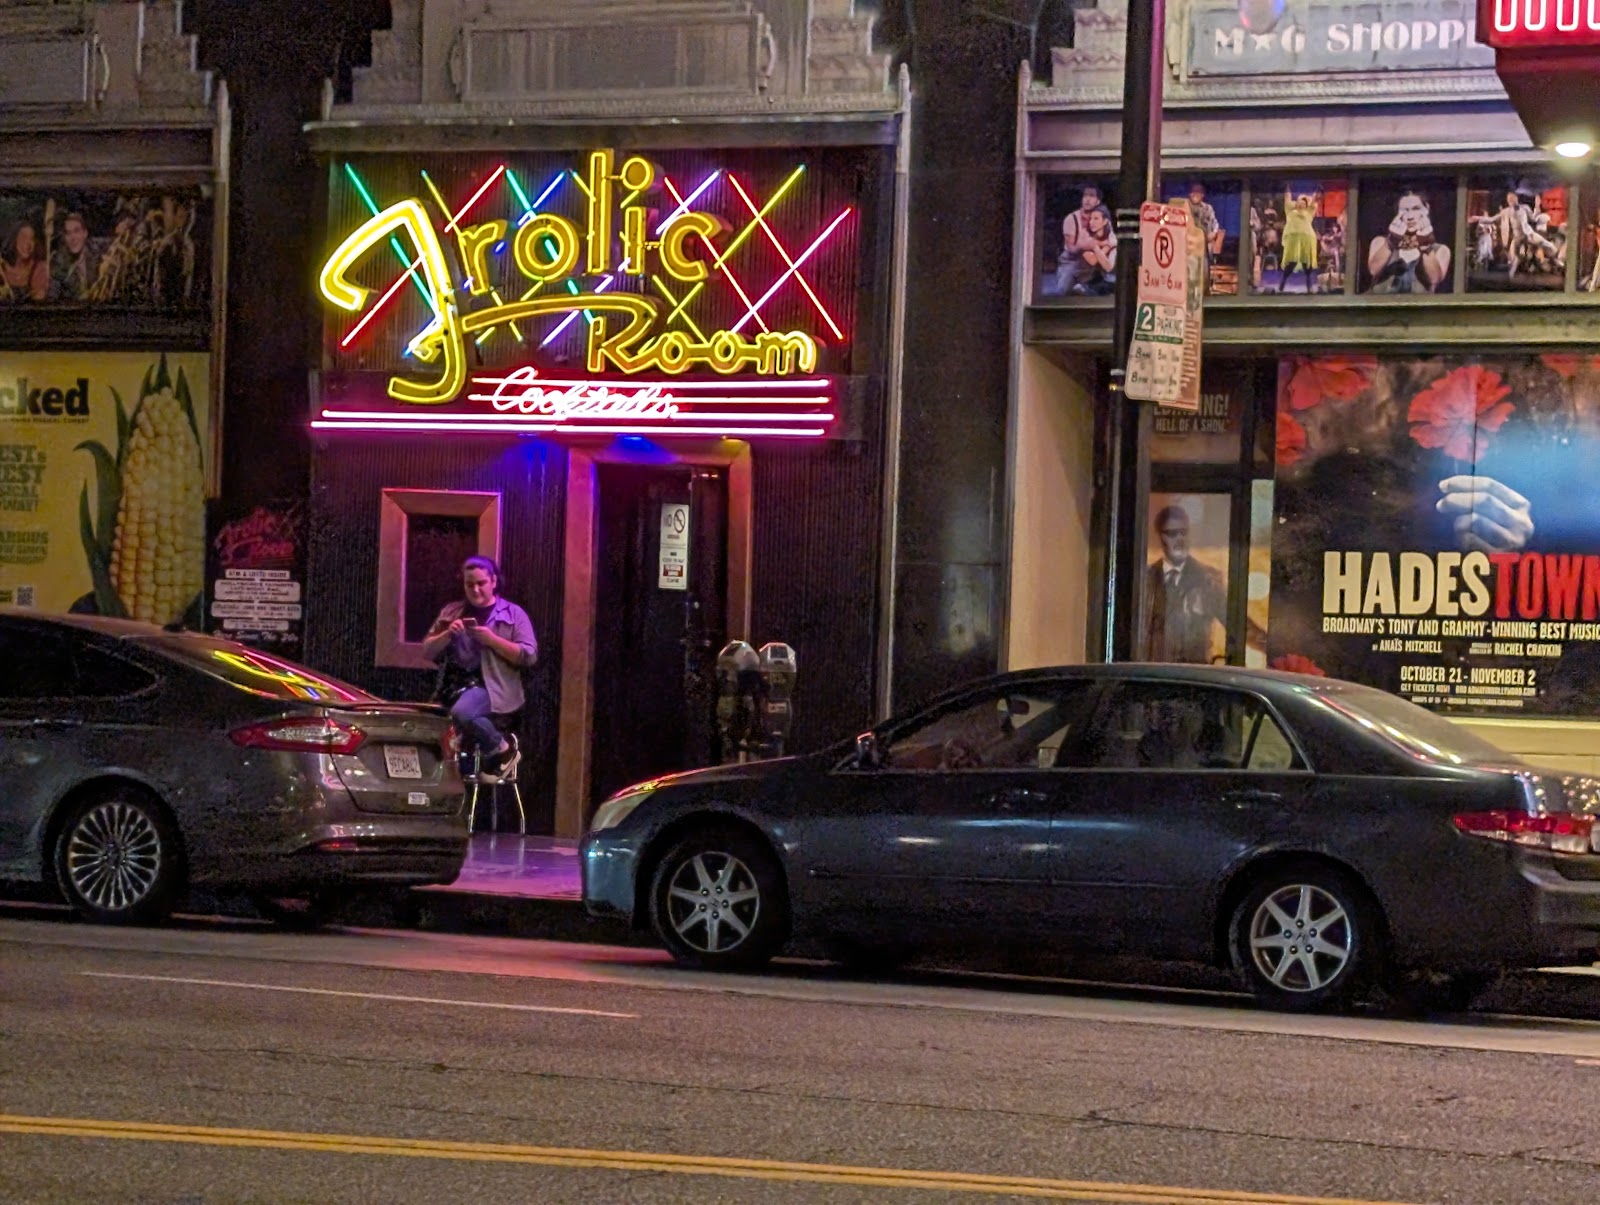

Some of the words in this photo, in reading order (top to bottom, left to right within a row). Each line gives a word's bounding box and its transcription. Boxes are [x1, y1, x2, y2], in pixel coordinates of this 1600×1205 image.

[319, 148, 735, 404] Frolic
[1141, 305, 1153, 330] 2
[462, 293, 819, 374] Room
[1322, 550, 1600, 621] HADESTOWN
[1322, 616, 1385, 634] BROADWAY'S
[1417, 619, 1439, 636] AND
[1540, 621, 1567, 640] BEST
[1405, 640, 1443, 653] MITCHELL
[1494, 642, 1525, 656] RACHEL
[1400, 665, 1446, 682] OCTOBER
[1449, 667, 1462, 683] 21
[1470, 667, 1525, 686] NOVEMBER
[1527, 669, 1536, 686] 2
